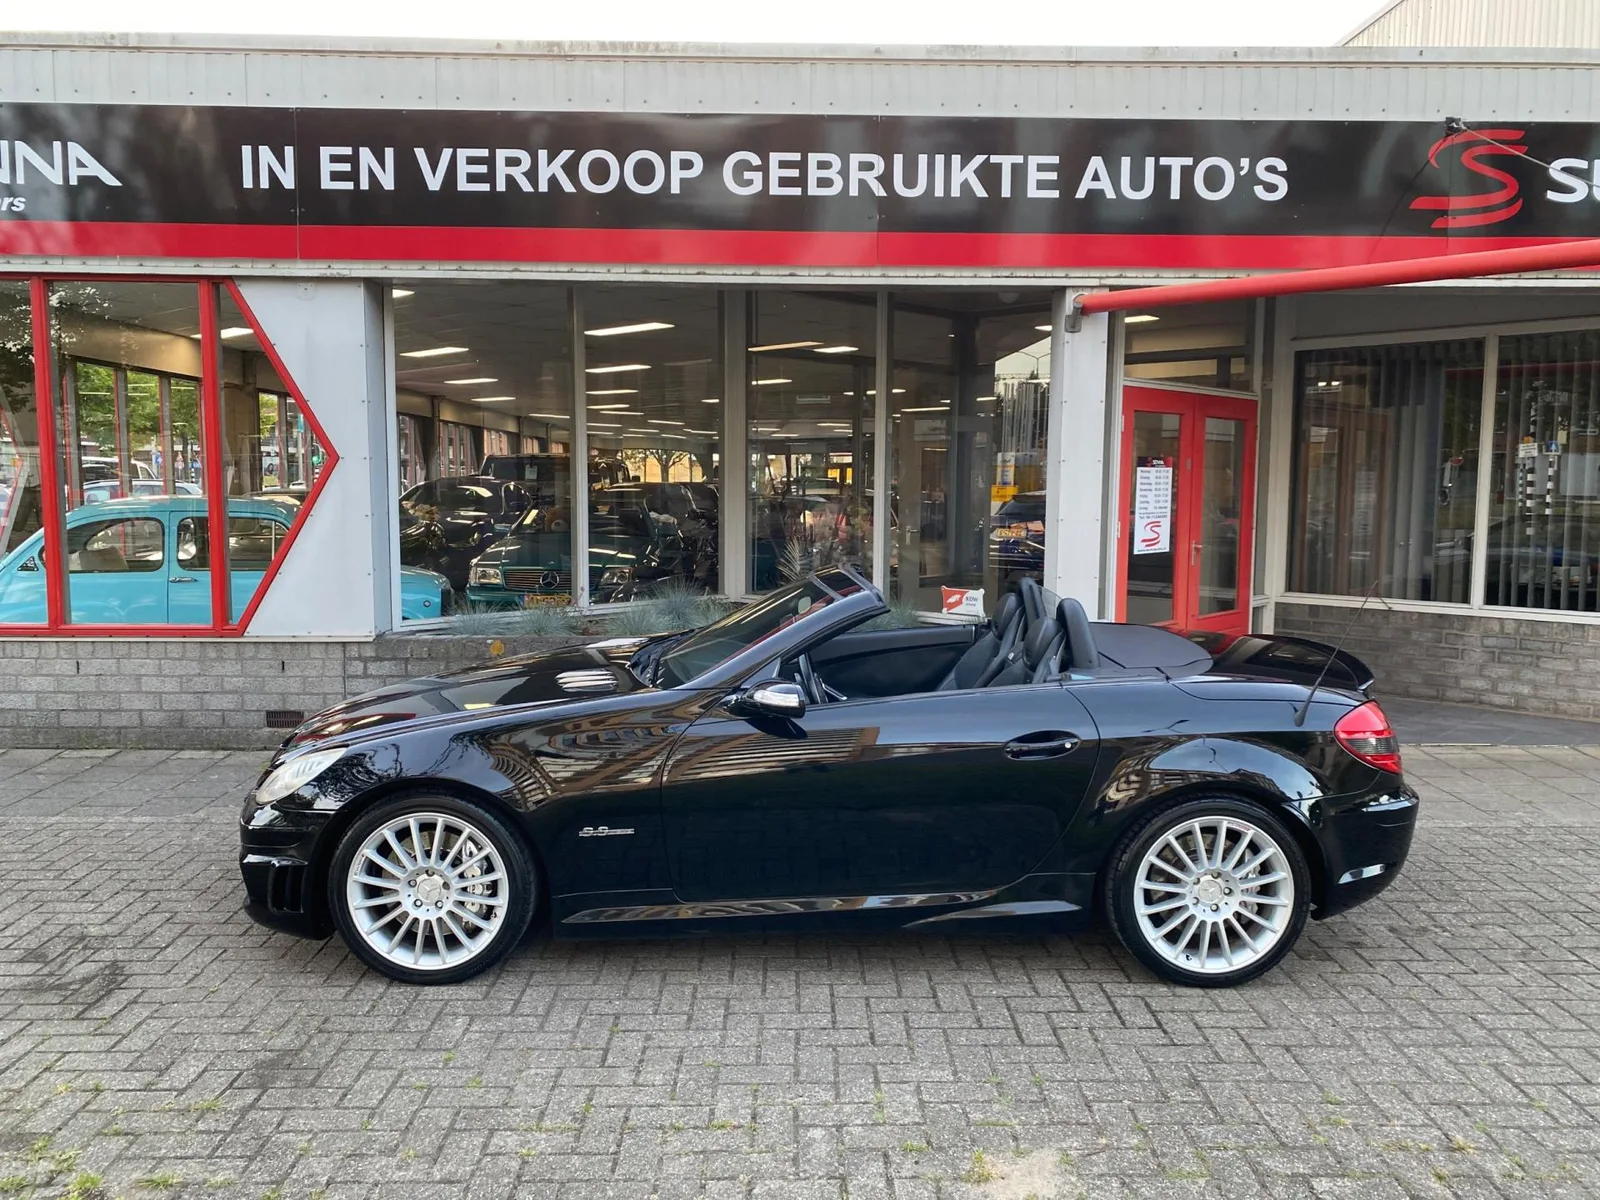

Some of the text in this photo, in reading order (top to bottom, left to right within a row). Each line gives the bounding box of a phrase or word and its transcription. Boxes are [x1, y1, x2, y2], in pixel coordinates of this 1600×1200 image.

[0, 139, 123, 187] NA
[241, 145, 1289, 202] IN EN VERKOOP GEBRUIKTE AUTO'S
[1546, 157, 1600, 203] S
[0, 196, 27, 212] rs
